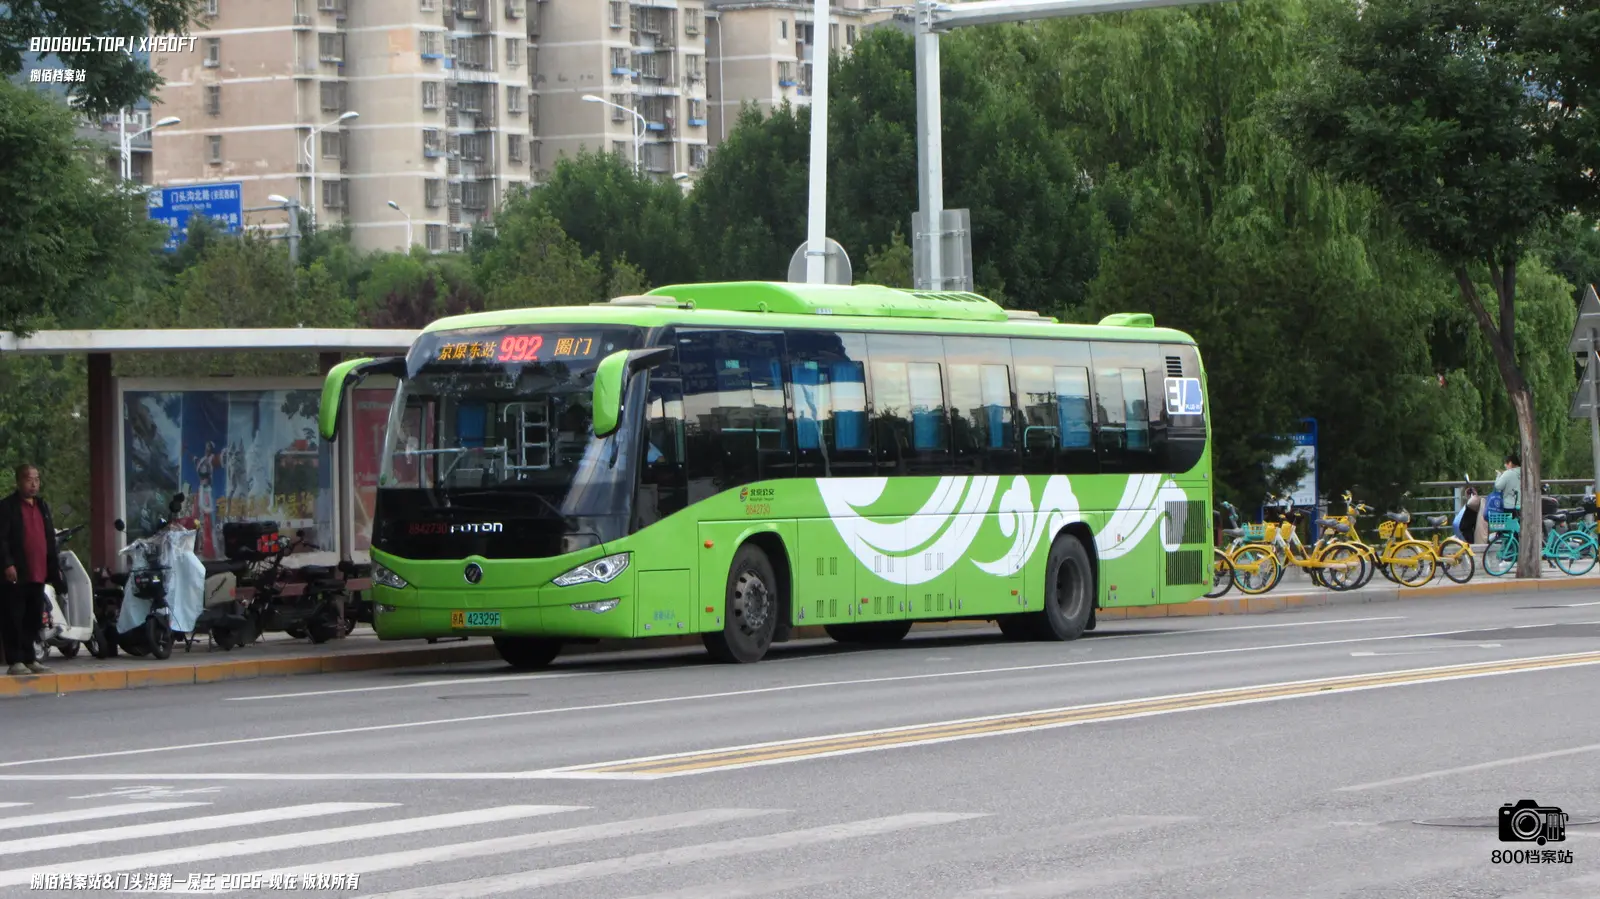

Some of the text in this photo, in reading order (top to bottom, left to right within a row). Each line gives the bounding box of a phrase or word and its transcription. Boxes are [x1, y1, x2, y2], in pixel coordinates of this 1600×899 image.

[438, 335, 593, 361] 京原东站 992 圈门
[450, 522, 503, 534] FOTON
[467, 612, 500, 625] 42329F
